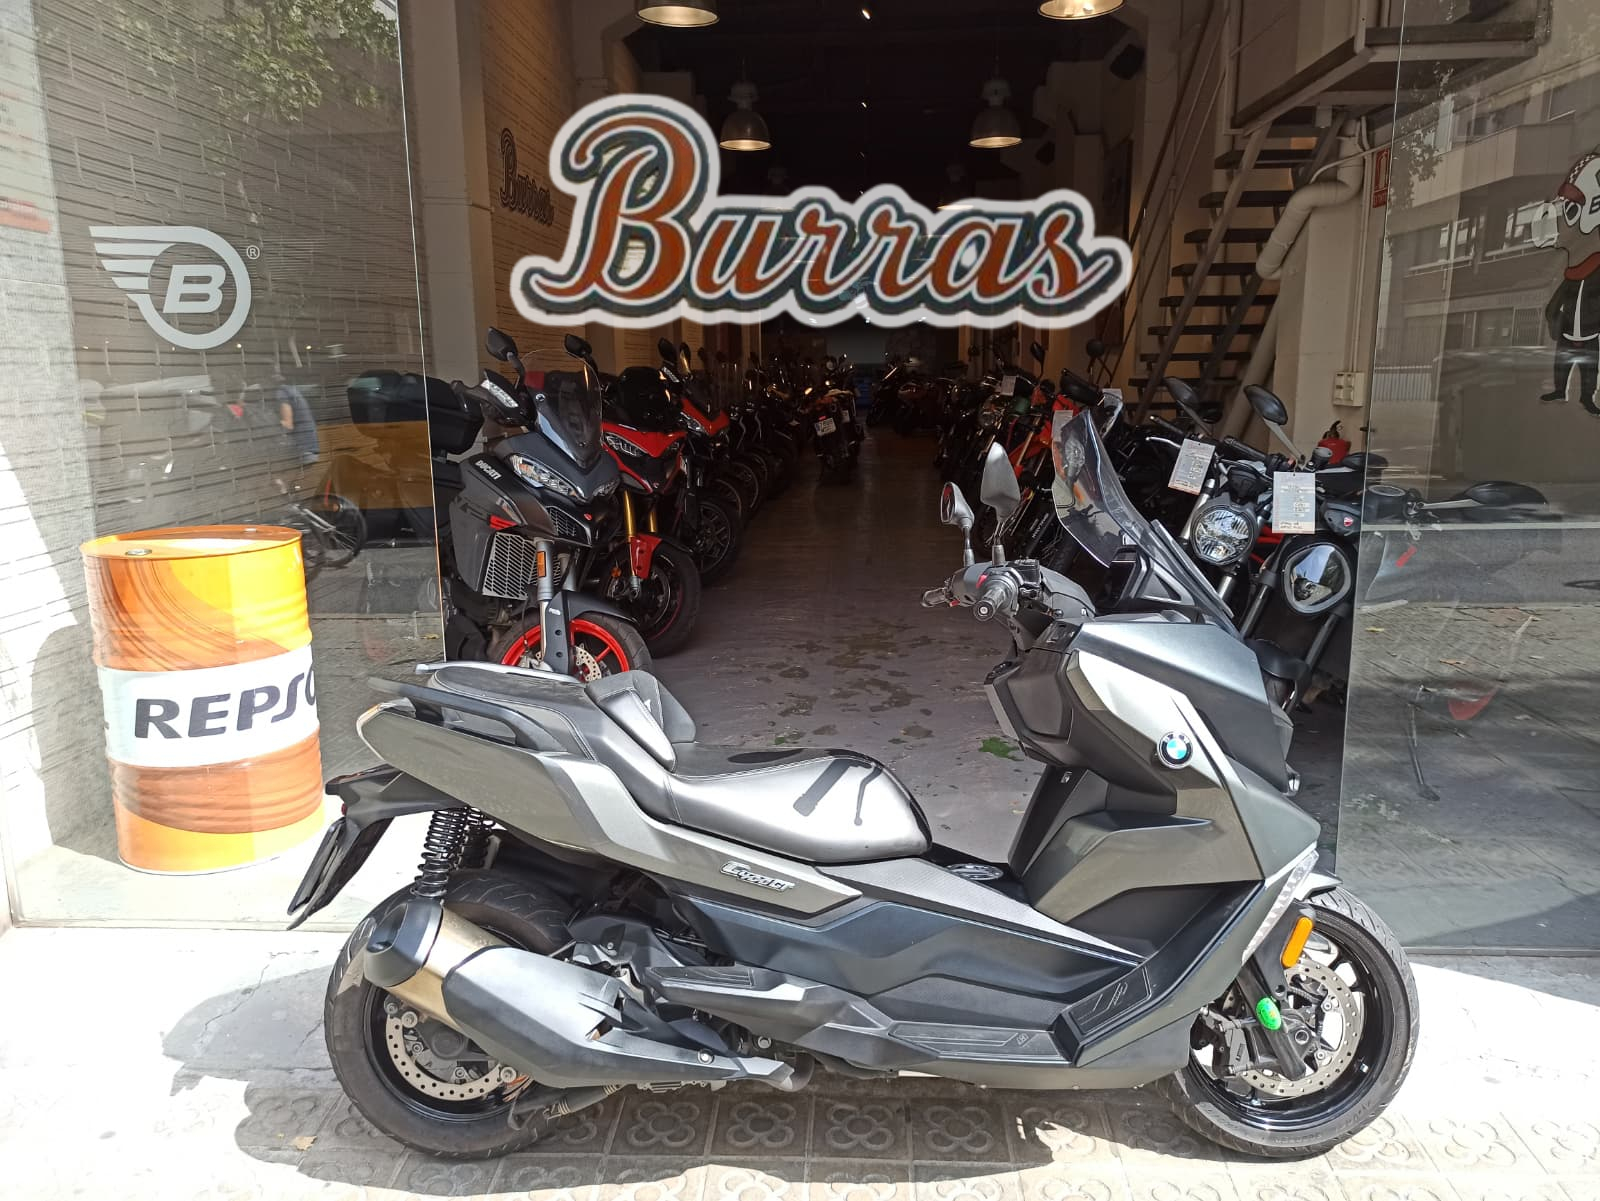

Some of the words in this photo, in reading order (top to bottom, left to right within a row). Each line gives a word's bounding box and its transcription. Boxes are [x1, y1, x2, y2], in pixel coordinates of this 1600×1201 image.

[514, 96, 1130, 326] Burras
[163, 264, 227, 314] B
[474, 459, 502, 480] DUCATI
